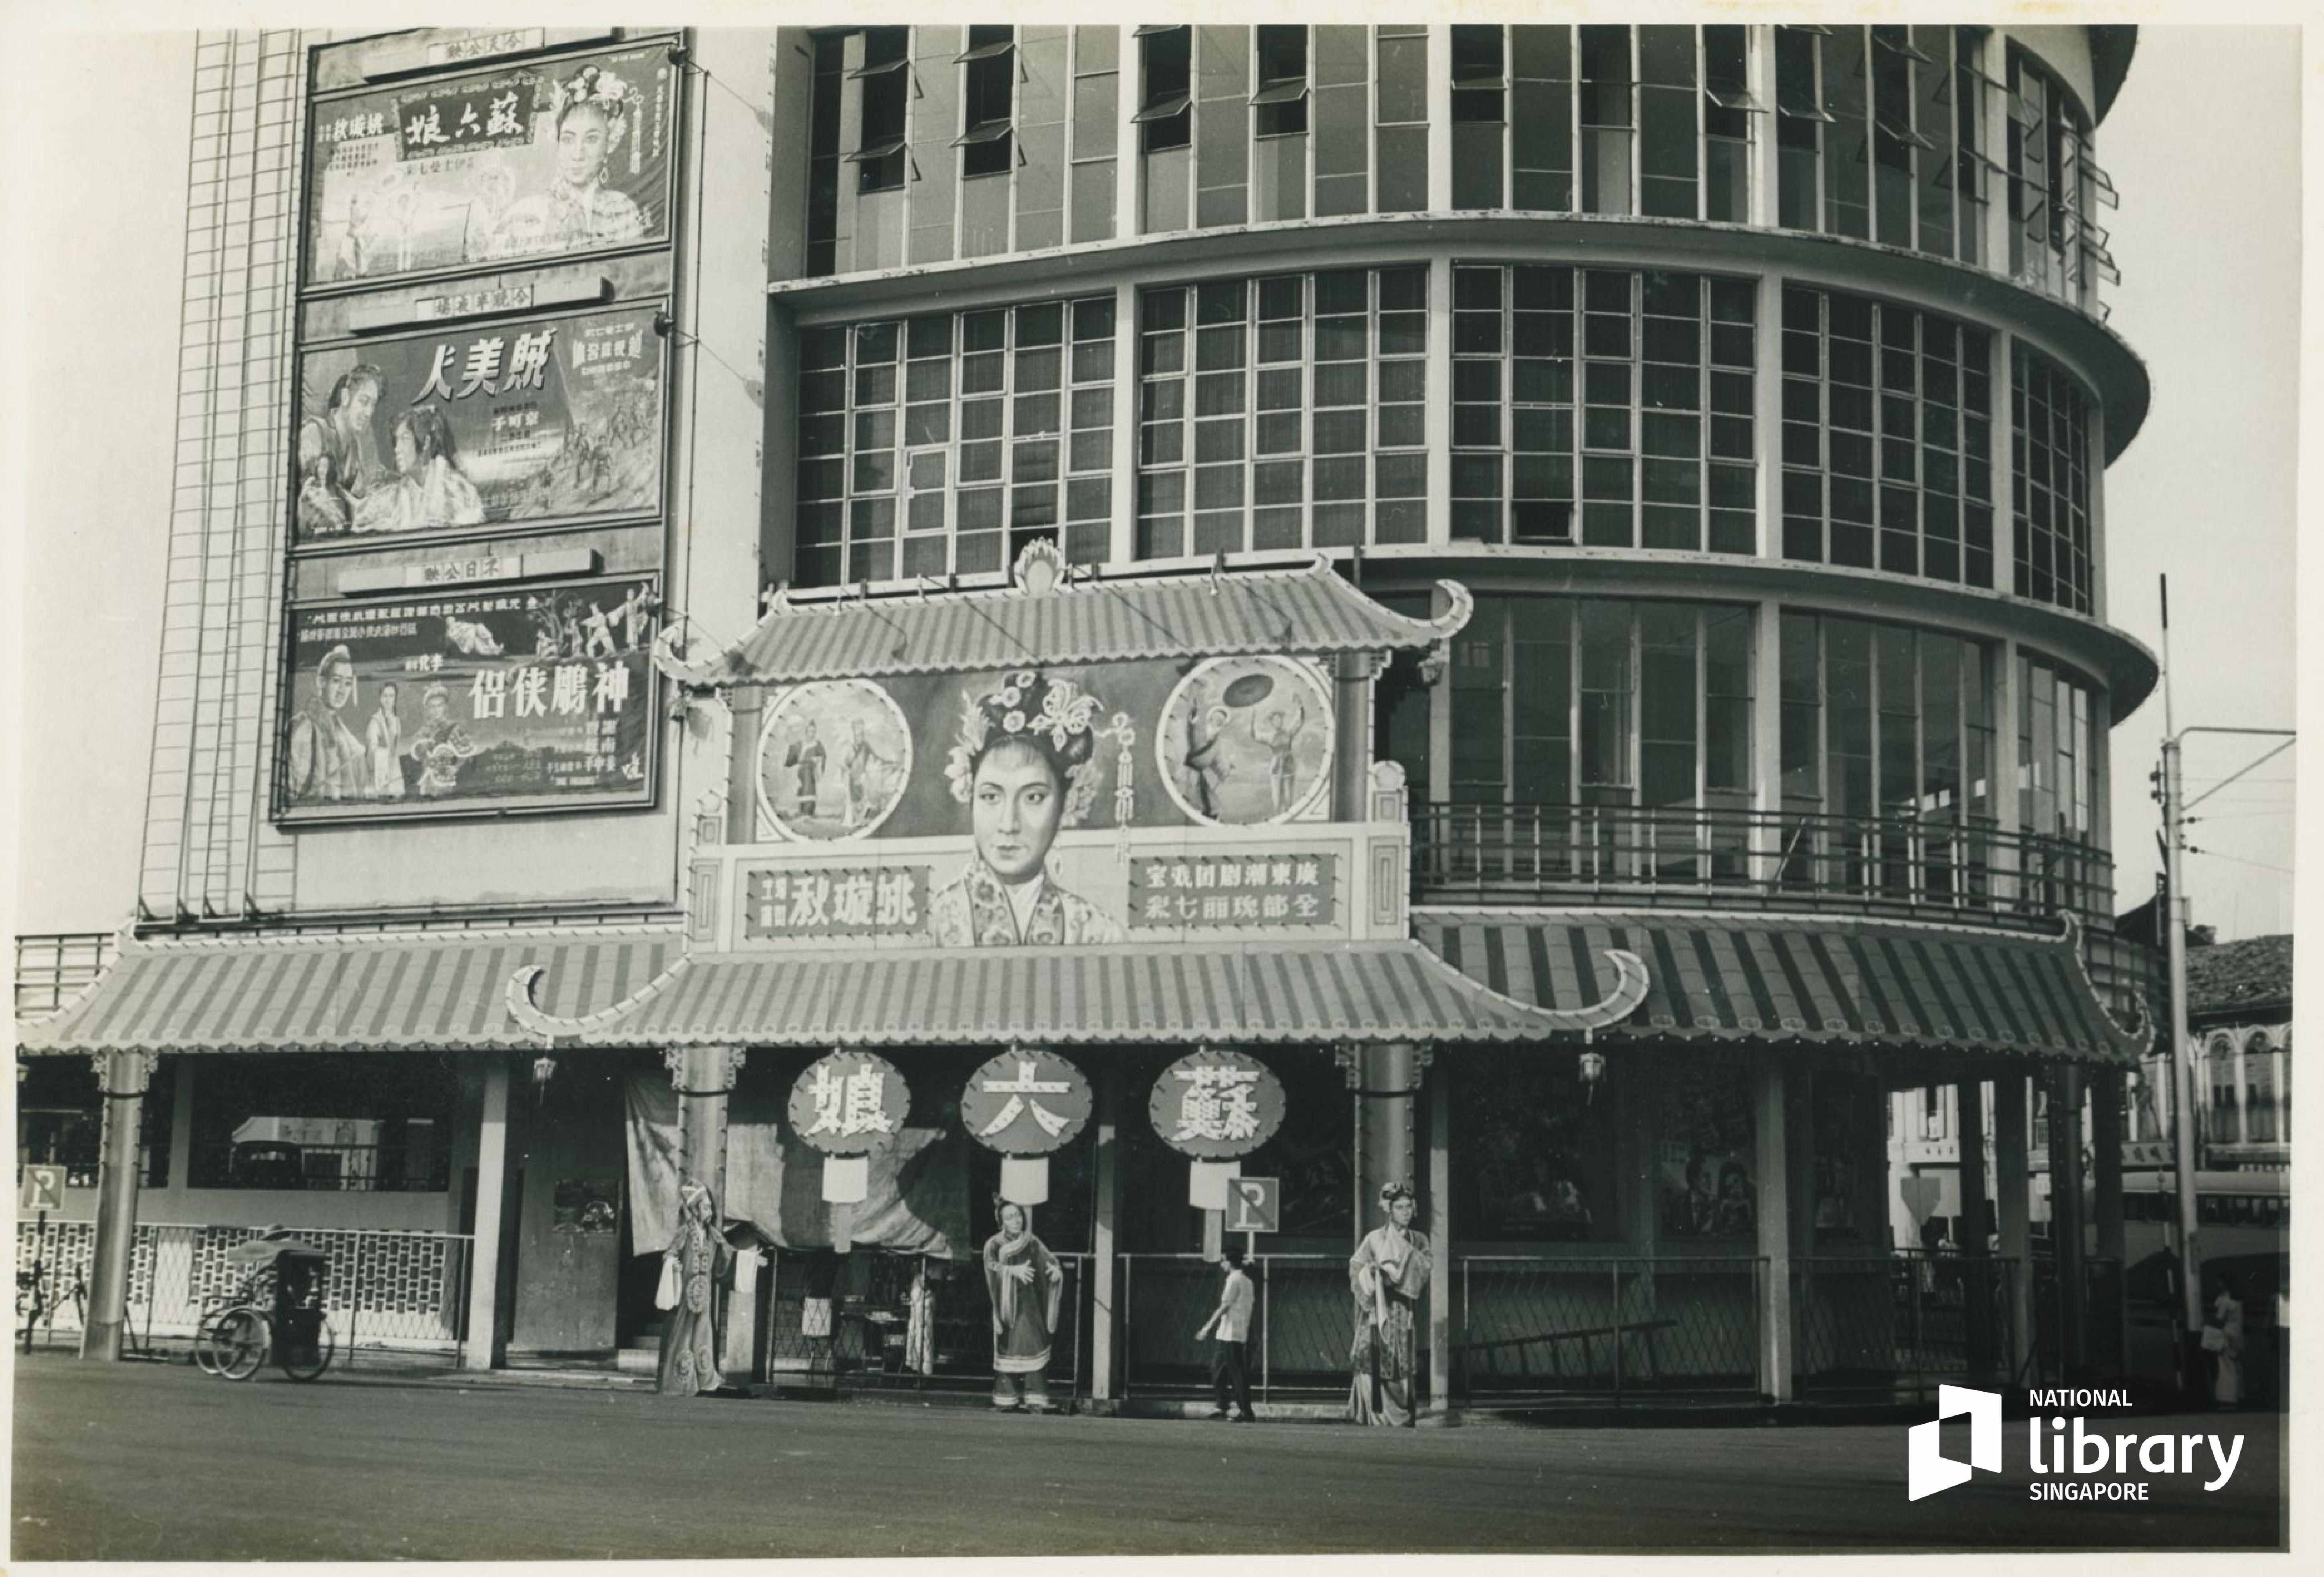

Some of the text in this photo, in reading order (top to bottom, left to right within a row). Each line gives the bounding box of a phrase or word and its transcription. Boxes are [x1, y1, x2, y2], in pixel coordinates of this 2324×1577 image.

[405, 91, 523, 145] 蘇六娘
[29, 1171, 54, 1208] P
[1235, 1183, 1264, 1228] P
